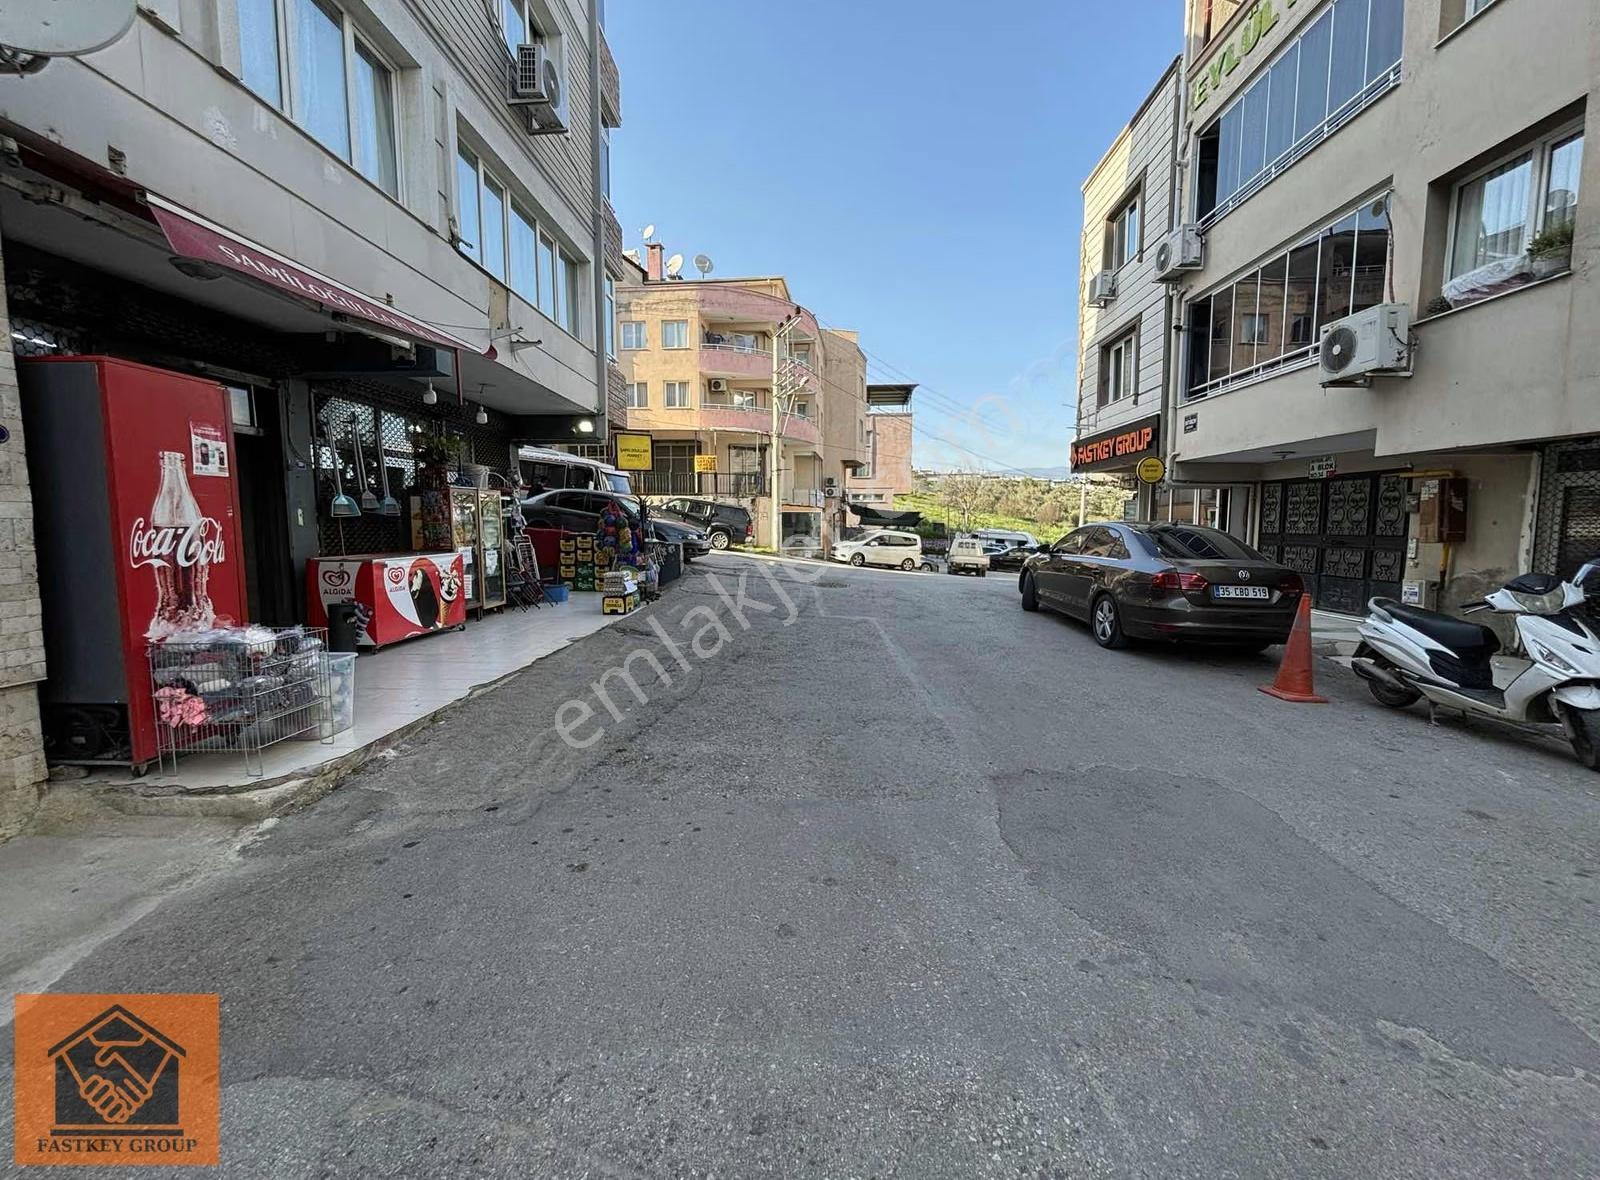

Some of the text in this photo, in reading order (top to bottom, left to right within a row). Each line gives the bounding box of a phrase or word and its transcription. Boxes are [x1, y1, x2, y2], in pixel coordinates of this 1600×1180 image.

[1191, 0, 1280, 112] EYLÜL
[1077, 427, 1152, 465] FASTKEY GROUP
[130, 517, 225, 569] Coca-Cola
[1220, 587, 1230, 596] 35
[1252, 588, 1267, 597] 519
